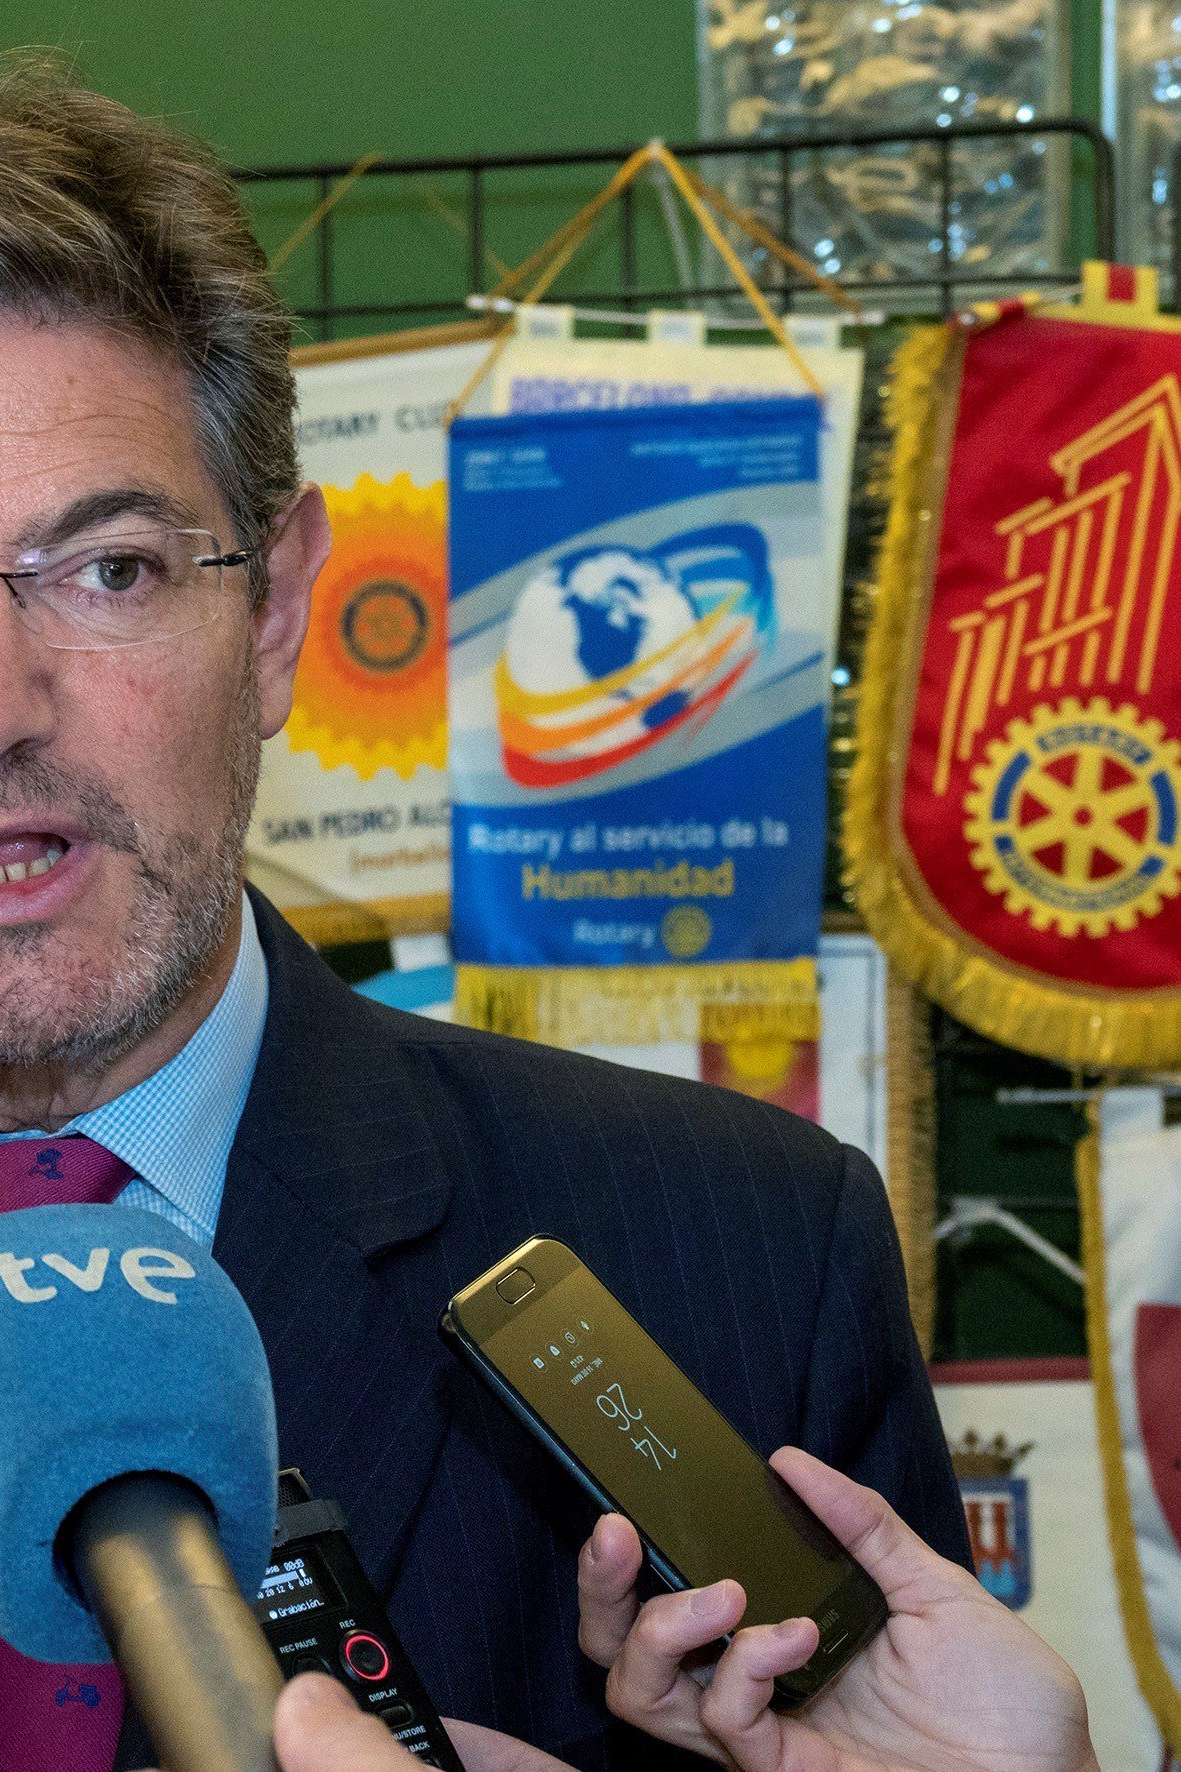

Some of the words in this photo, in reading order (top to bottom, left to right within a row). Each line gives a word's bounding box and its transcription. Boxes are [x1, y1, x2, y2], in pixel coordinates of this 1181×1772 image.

[295, 411, 379, 446] OTARY
[394, 400, 449, 434] CLU
[263, 816, 314, 845] SAN
[320, 804, 402, 838] PEDRO
[469, 821, 565, 861] Rotary
[571, 821, 598, 851] al
[603, 818, 716, 851] servicio
[720, 818, 757, 849] de
[761, 816, 790, 848] la
[522, 856, 736, 900] Humanidad
[572, 916, 656, 949] Rotary
[595, 1382, 644, 1432] 26
[630, 1425, 678, 1472] 14
[339, 1619, 356, 1630] REC
[279, 1643, 295, 1654] REC
[294, 1637, 318, 1650] PAUSE
[368, 1687, 398, 1702] DISPLAY
[409, 1740, 430, 1753] BACK
